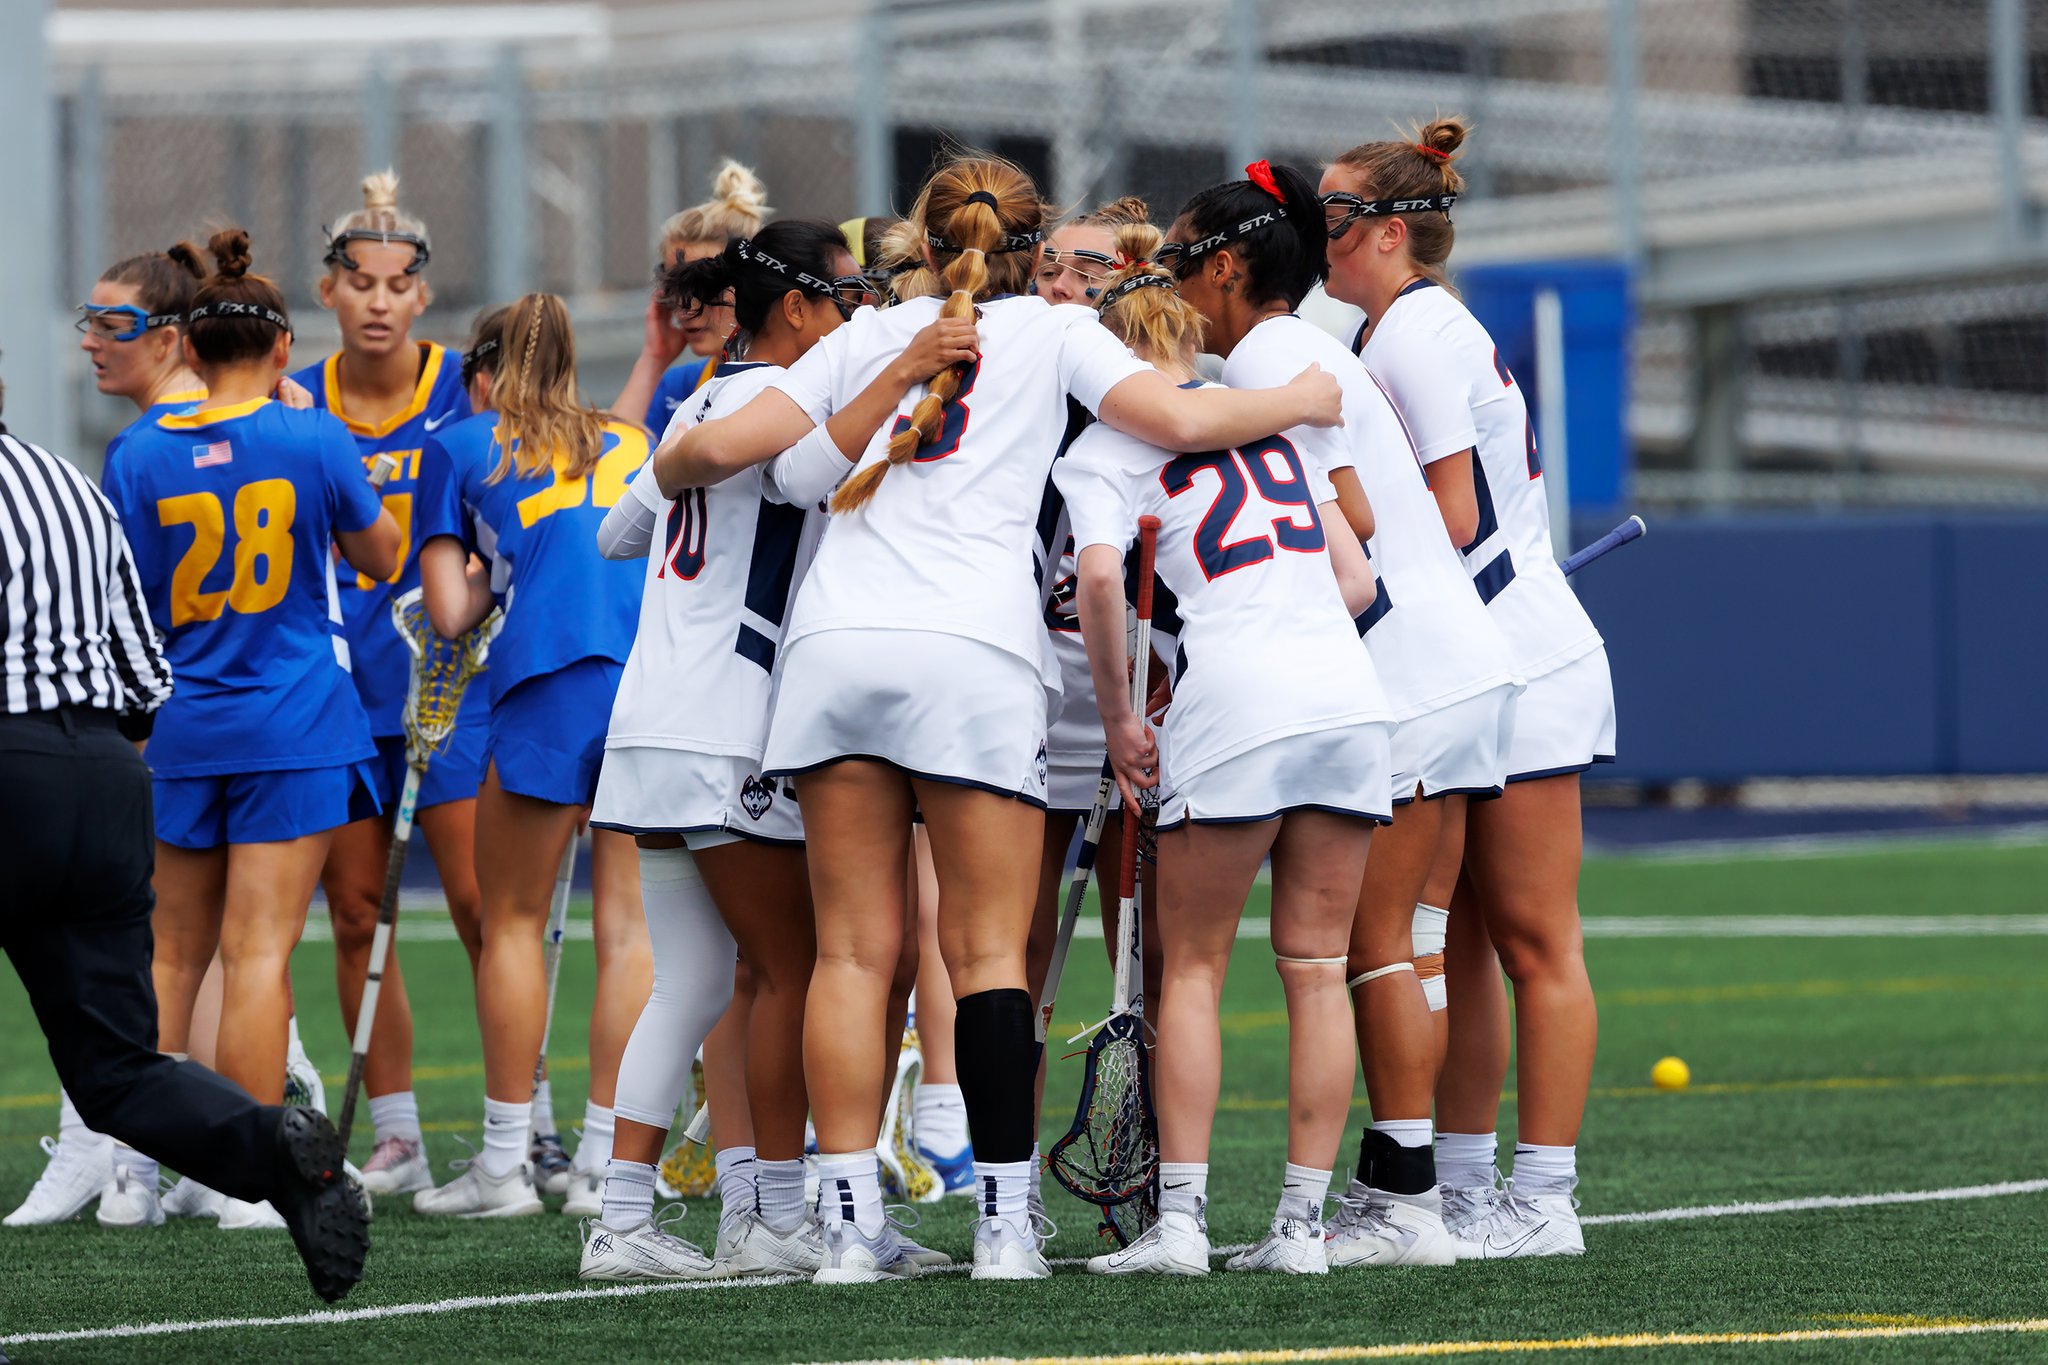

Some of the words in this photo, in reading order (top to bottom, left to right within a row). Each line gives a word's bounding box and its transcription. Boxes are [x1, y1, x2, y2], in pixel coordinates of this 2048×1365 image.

[1392, 199, 1432, 212] STX
[1190, 232, 1228, 256] STX
[1238, 212, 1275, 234] STX
[754, 251, 788, 274] STX
[796, 272, 835, 296] STX
[147, 313, 181, 327] STX
[1159, 433, 1326, 583] 29
[157, 478, 296, 628] 28
